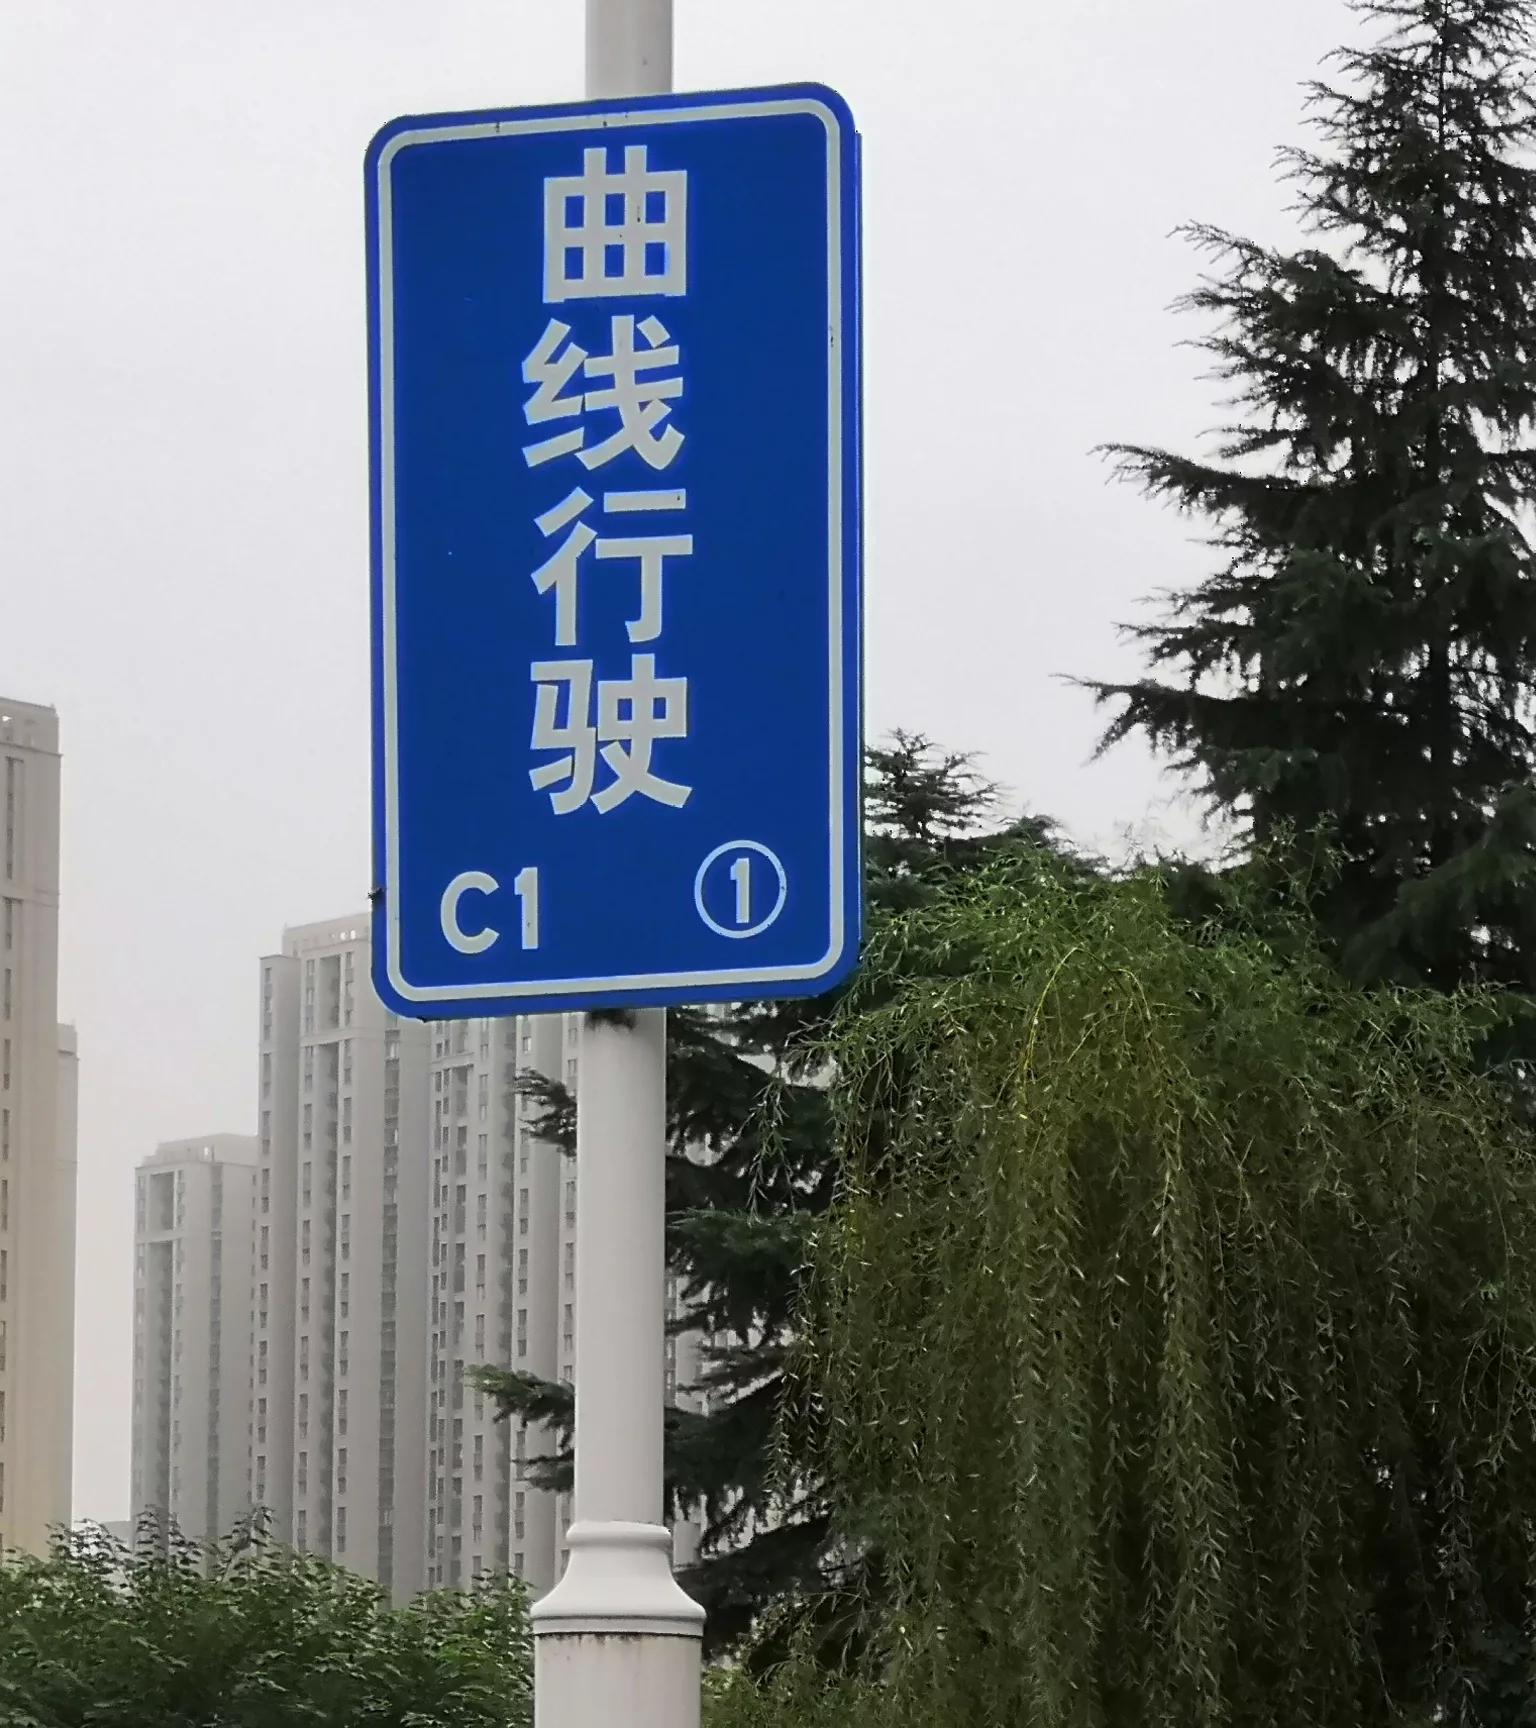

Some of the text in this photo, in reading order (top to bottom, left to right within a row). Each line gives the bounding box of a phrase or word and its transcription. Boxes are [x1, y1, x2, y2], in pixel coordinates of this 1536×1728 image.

[521, 144, 693, 816] 曲线行驶
[439, 865, 540, 955] C1
